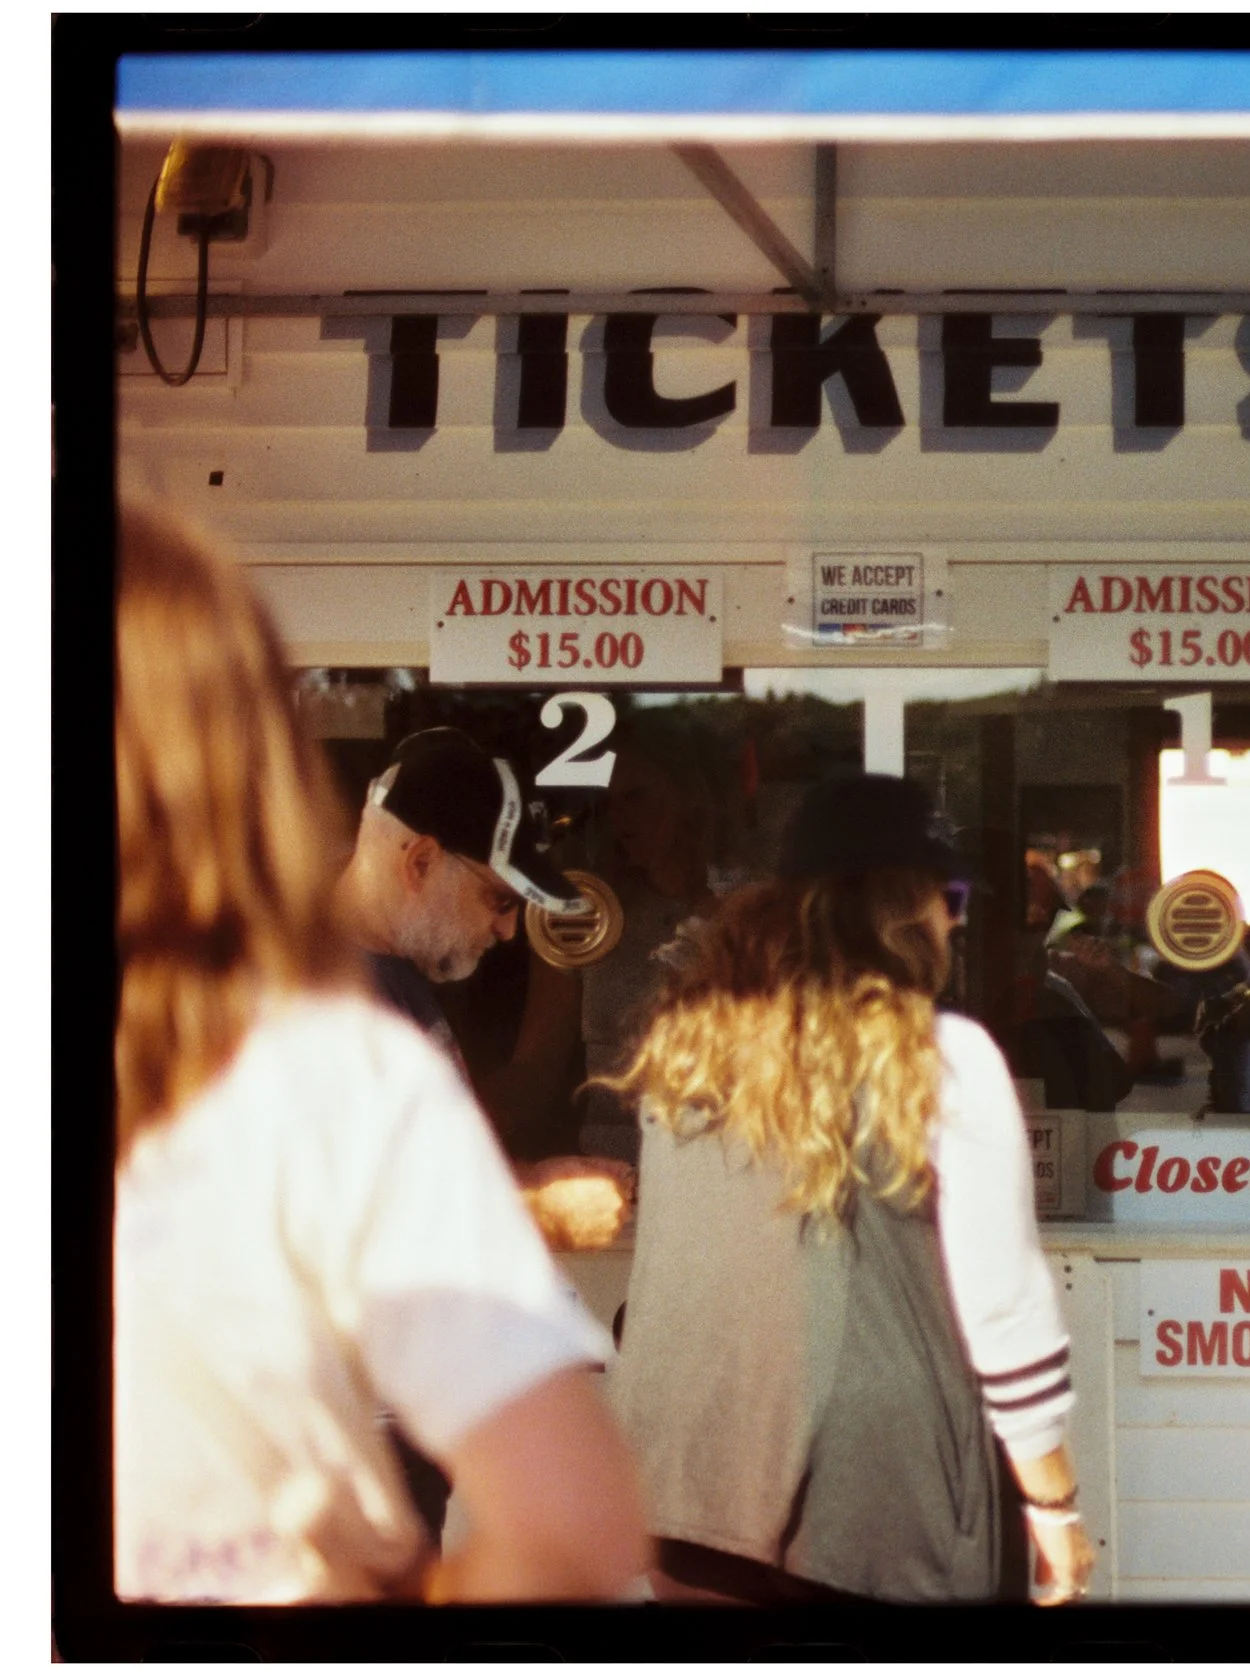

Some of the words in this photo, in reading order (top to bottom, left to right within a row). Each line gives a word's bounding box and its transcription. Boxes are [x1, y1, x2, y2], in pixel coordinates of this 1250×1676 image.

[820, 565, 847, 587] WE
[851, 565, 915, 587] ACCEPT
[445, 578, 709, 618] ADMISSION
[820, 598, 868, 616] CREDIT
[871, 597, 918, 616] CARDS
[507, 628, 646, 670] $15.00
[535, 691, 618, 788] 2
[1162, 691, 1228, 786] 1
